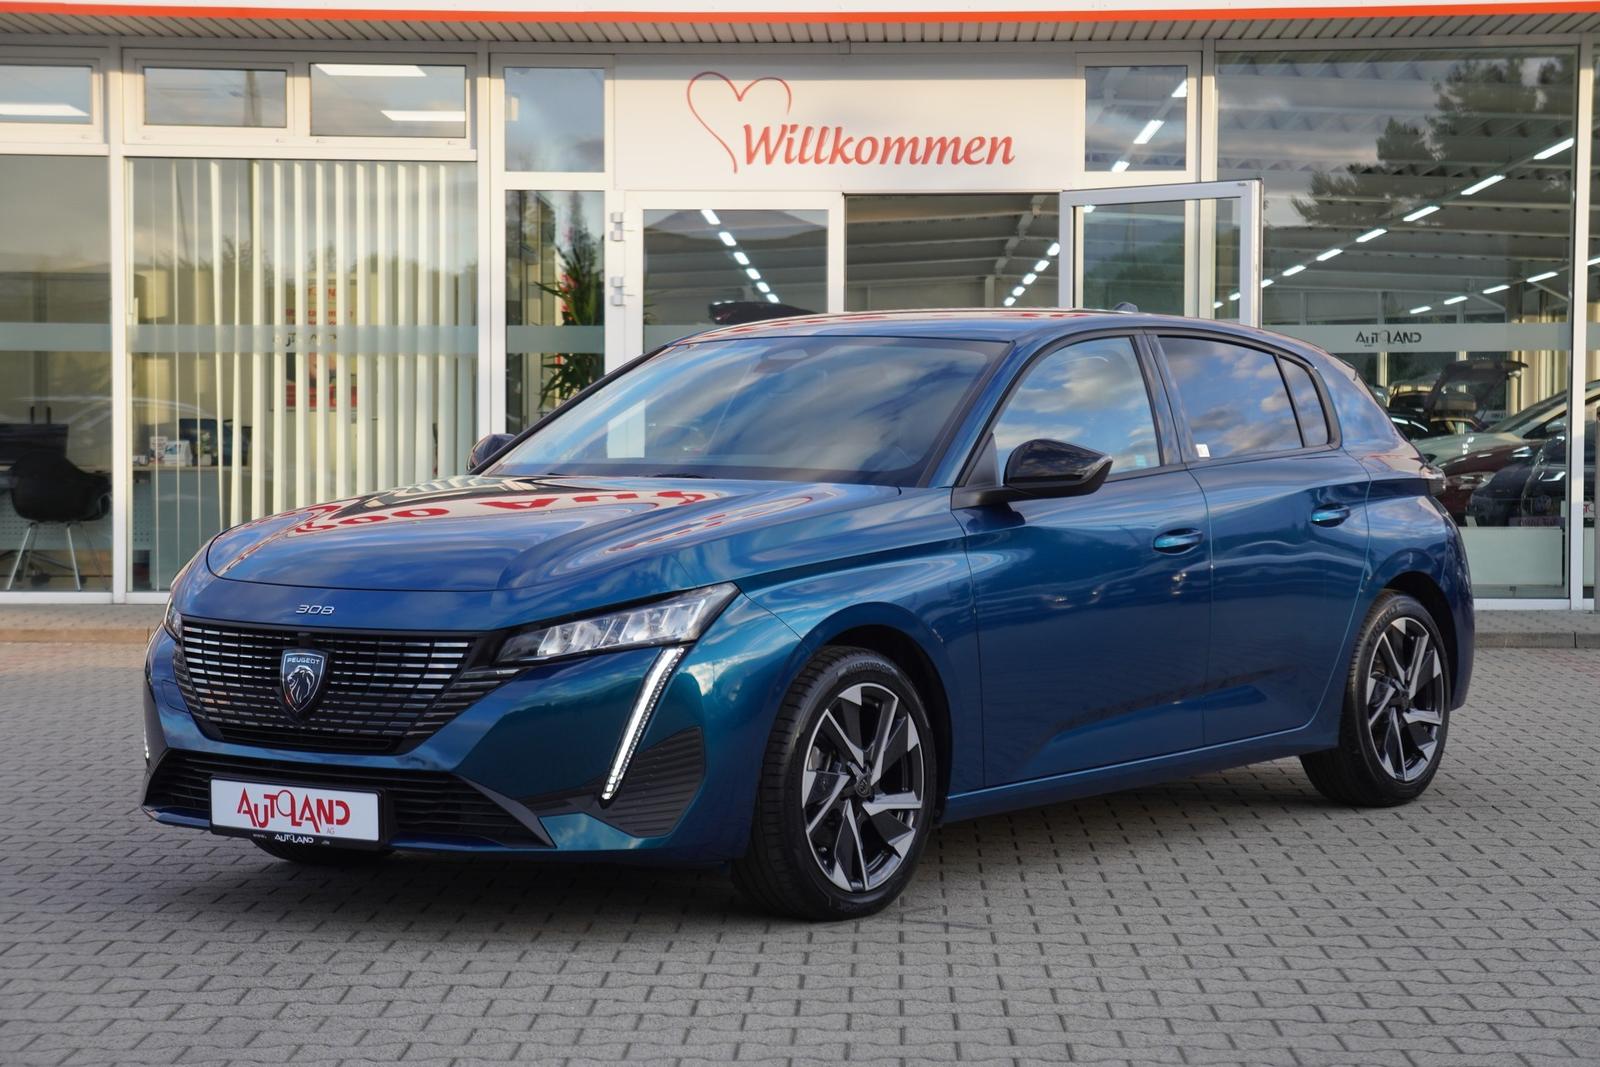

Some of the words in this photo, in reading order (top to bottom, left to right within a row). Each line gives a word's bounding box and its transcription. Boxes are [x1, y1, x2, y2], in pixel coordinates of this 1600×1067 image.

[743, 124, 1015, 165] Willkommen
[296, 604, 335, 615] 308
[287, 657, 320, 665] PEUGEOT
[326, 826, 336, 835] AG
